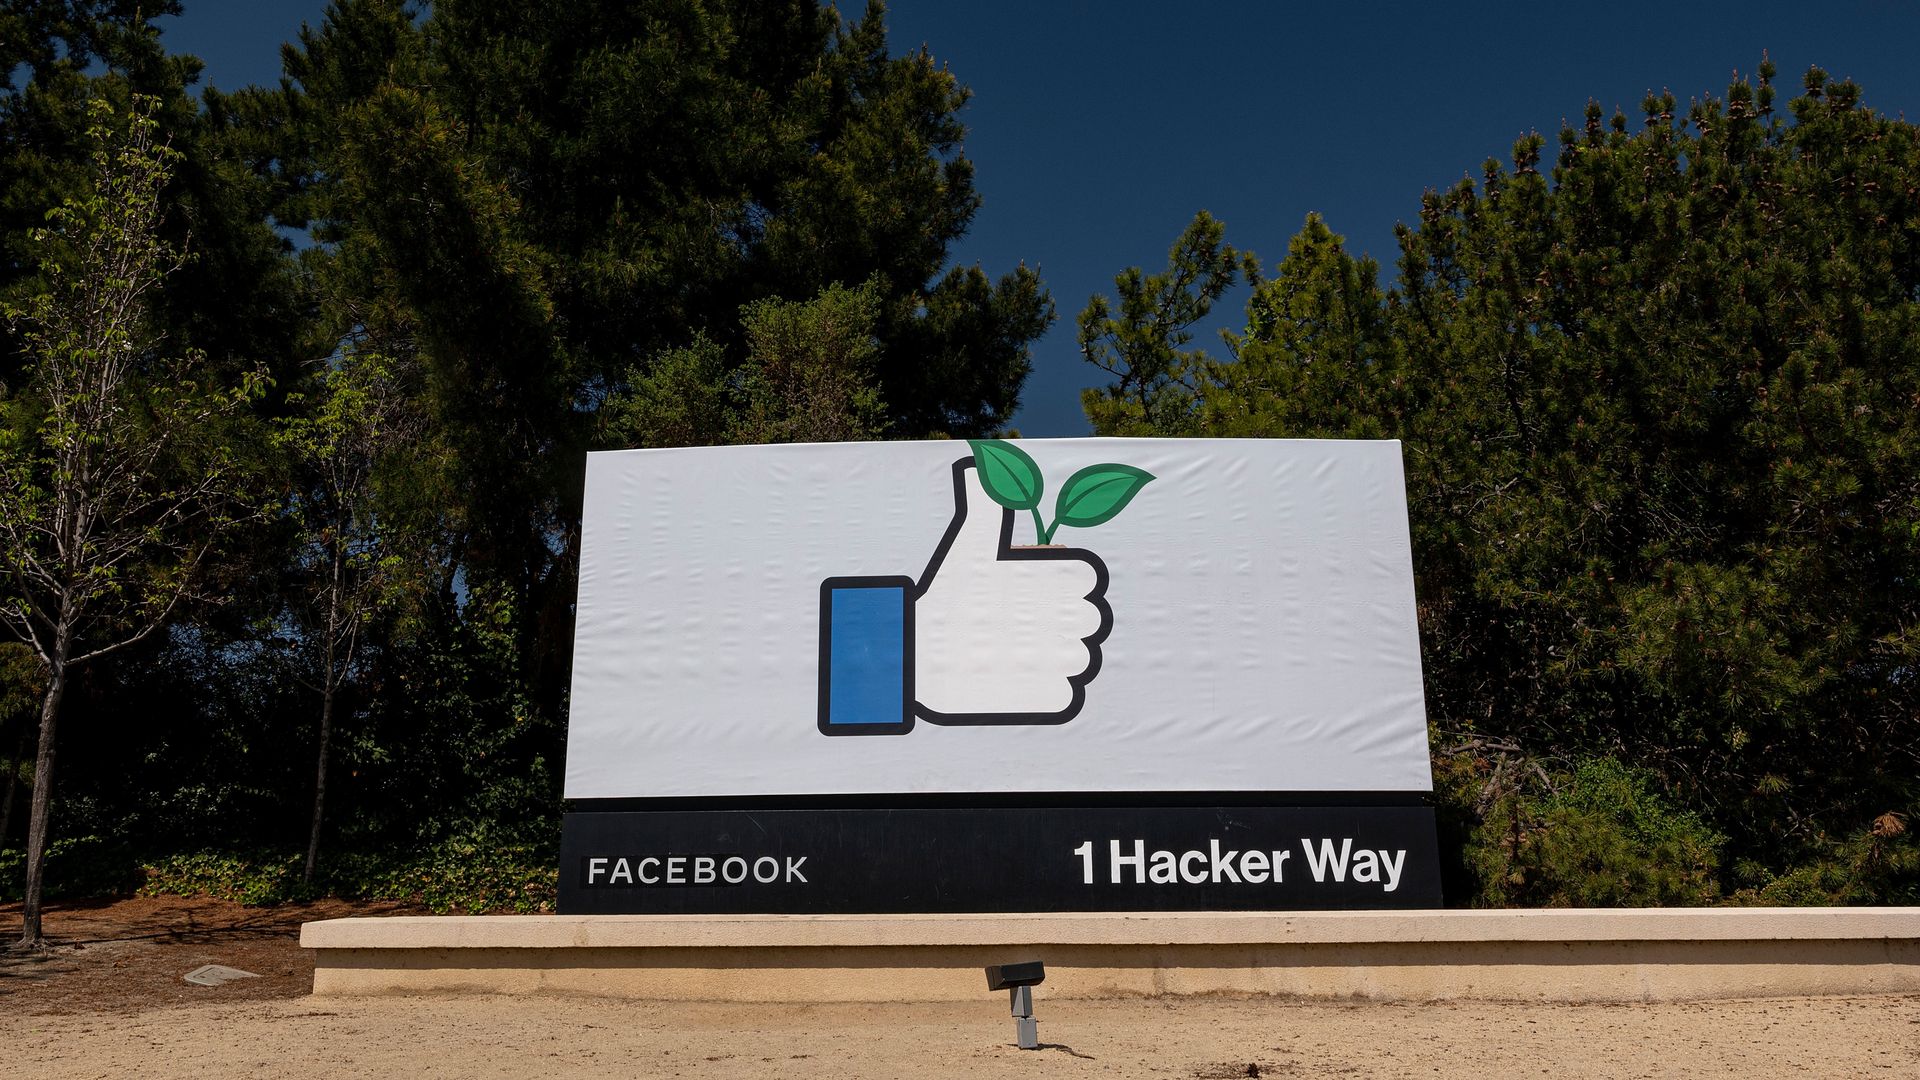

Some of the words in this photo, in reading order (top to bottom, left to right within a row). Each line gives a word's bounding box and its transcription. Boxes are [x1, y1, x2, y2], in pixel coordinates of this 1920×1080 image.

[588, 856, 809, 884] FACEBOOK
[1074, 840, 1094, 884] 1
[1110, 838, 1291, 884] Hacker
[1300, 838, 1407, 893] Way
